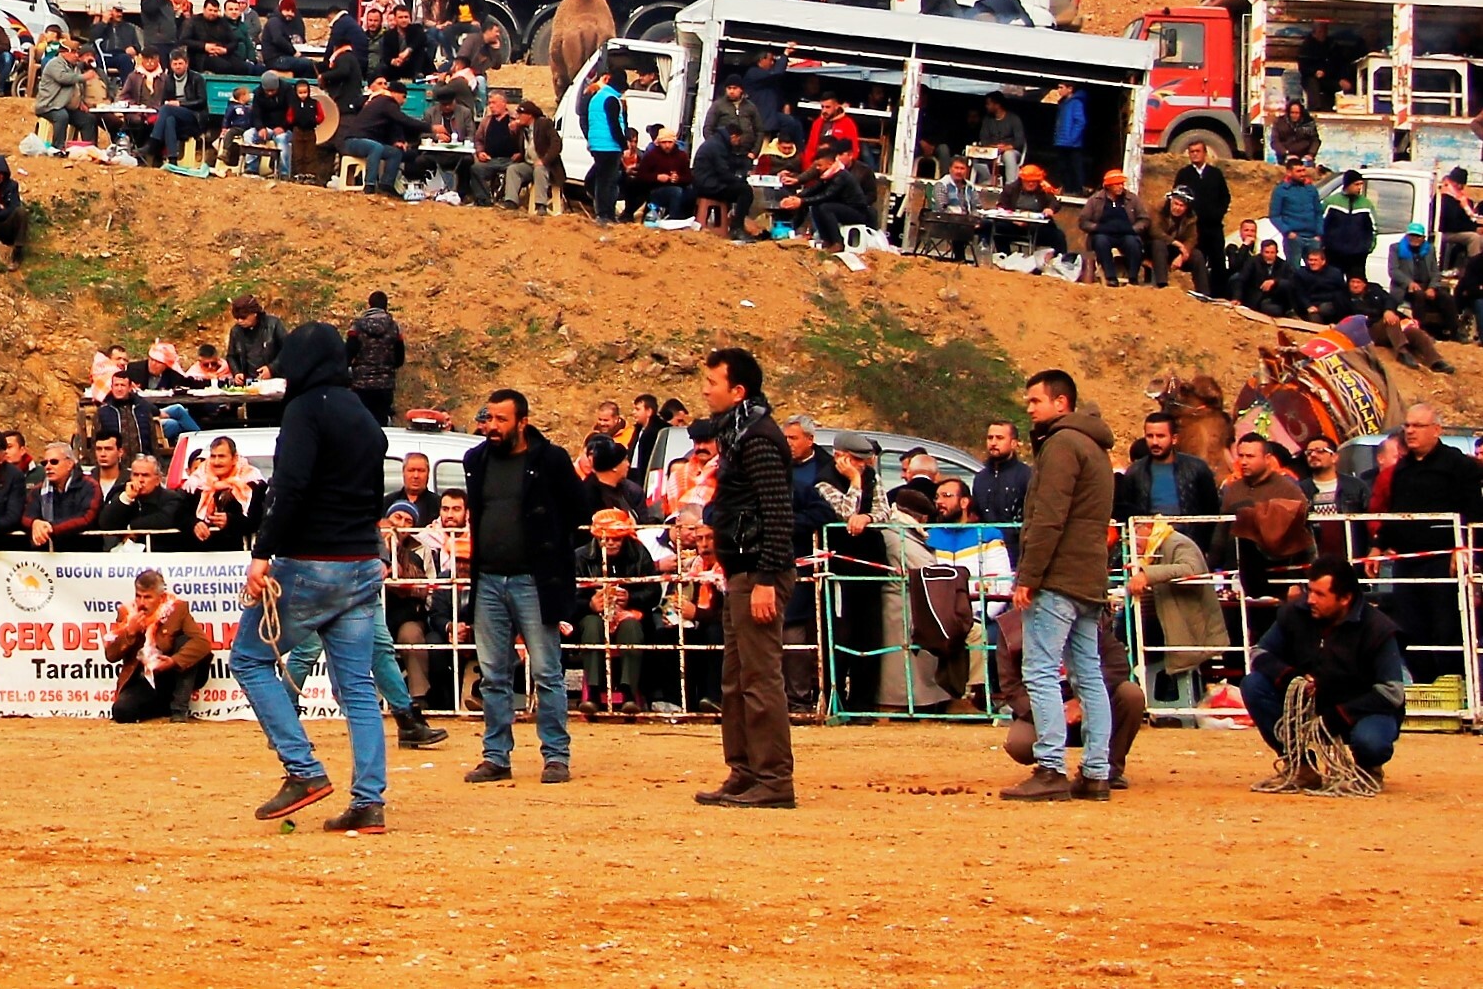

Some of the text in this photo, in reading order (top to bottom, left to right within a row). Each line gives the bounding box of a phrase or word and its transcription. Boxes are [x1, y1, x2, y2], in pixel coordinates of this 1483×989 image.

[56, 562, 103, 578] BUGÜN
[39, 690, 63, 702] 256
[67, 690, 89, 702] 361
[203, 689, 227, 701] 208
